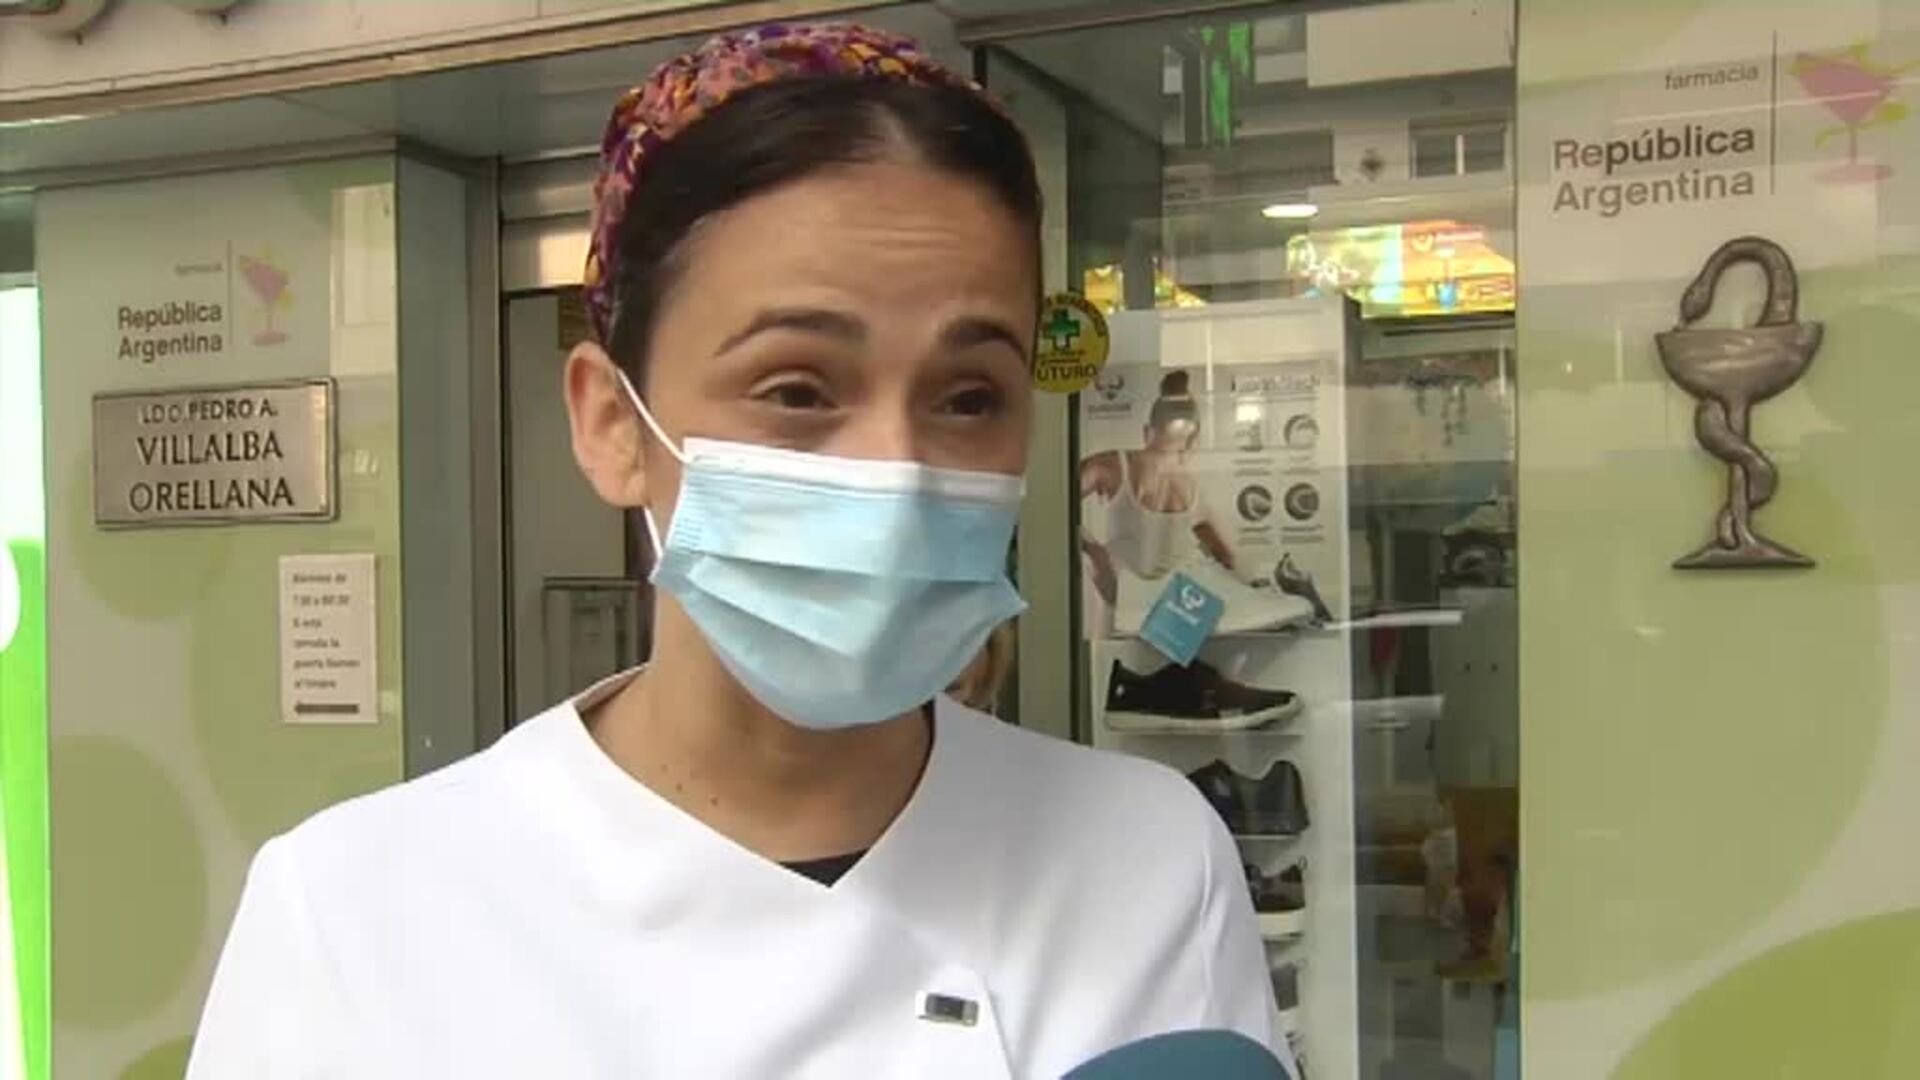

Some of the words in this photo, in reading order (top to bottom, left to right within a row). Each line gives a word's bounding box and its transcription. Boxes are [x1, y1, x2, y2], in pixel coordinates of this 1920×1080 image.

[1665, 62, 1759, 90] farmacia
[1554, 124, 1756, 176] República
[1553, 169, 1755, 218] Argentina
[117, 300, 223, 332] República
[117, 333, 223, 363] Argentina
[1036, 362, 1097, 381] UTURO
[189, 398, 254, 422] PEDRO
[259, 398, 278, 418] A.
[137, 430, 283, 466] VILLALBA
[129, 476, 295, 513] ORELLANA
